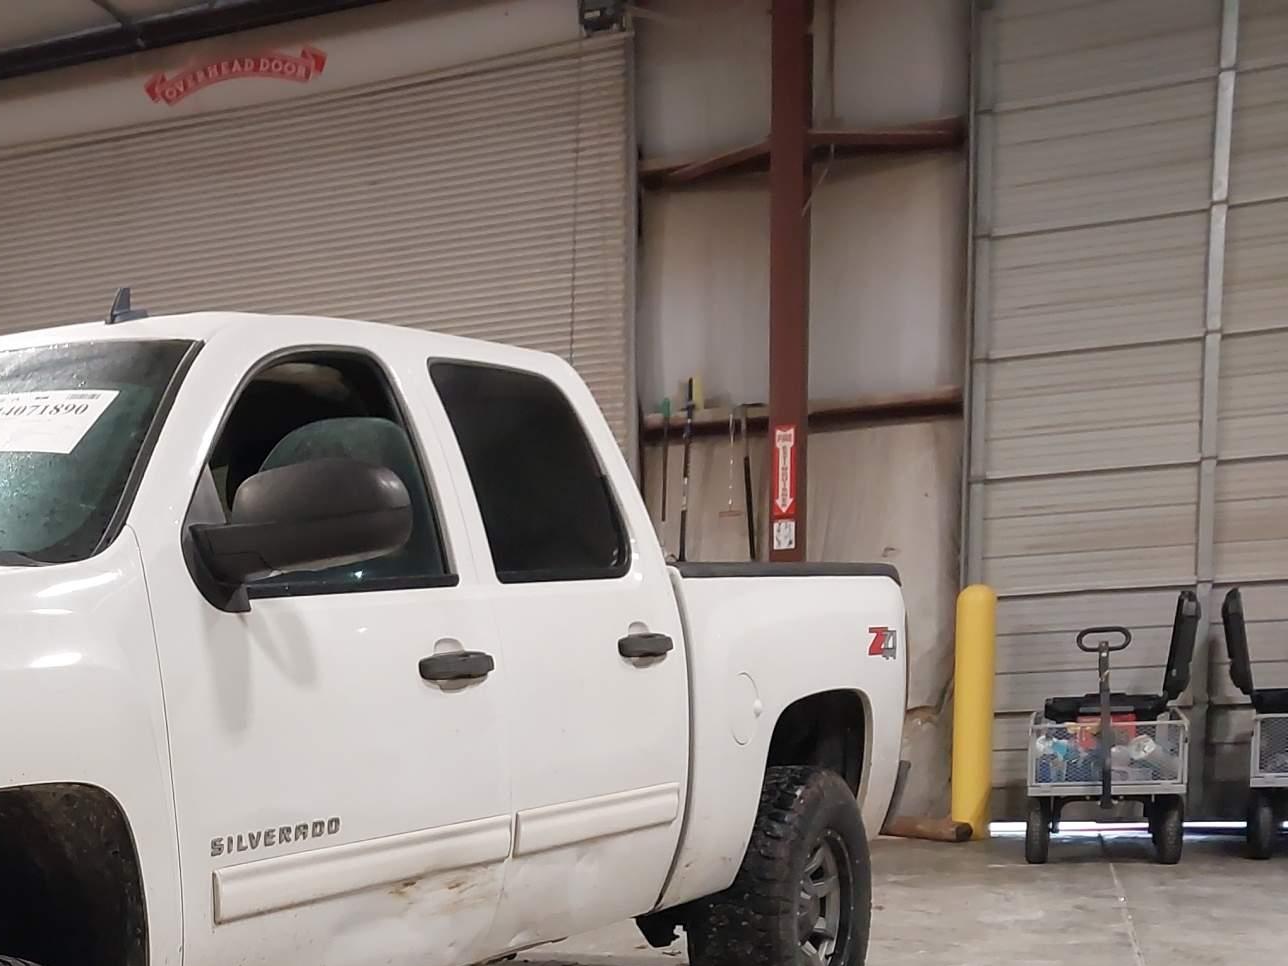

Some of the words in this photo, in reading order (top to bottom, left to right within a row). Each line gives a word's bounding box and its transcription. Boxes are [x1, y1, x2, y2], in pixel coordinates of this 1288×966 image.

[165, 58, 254, 99] OVERHEAD
[259, 58, 306, 78] DOOR
[210, 817, 341, 857] SILVERADO
